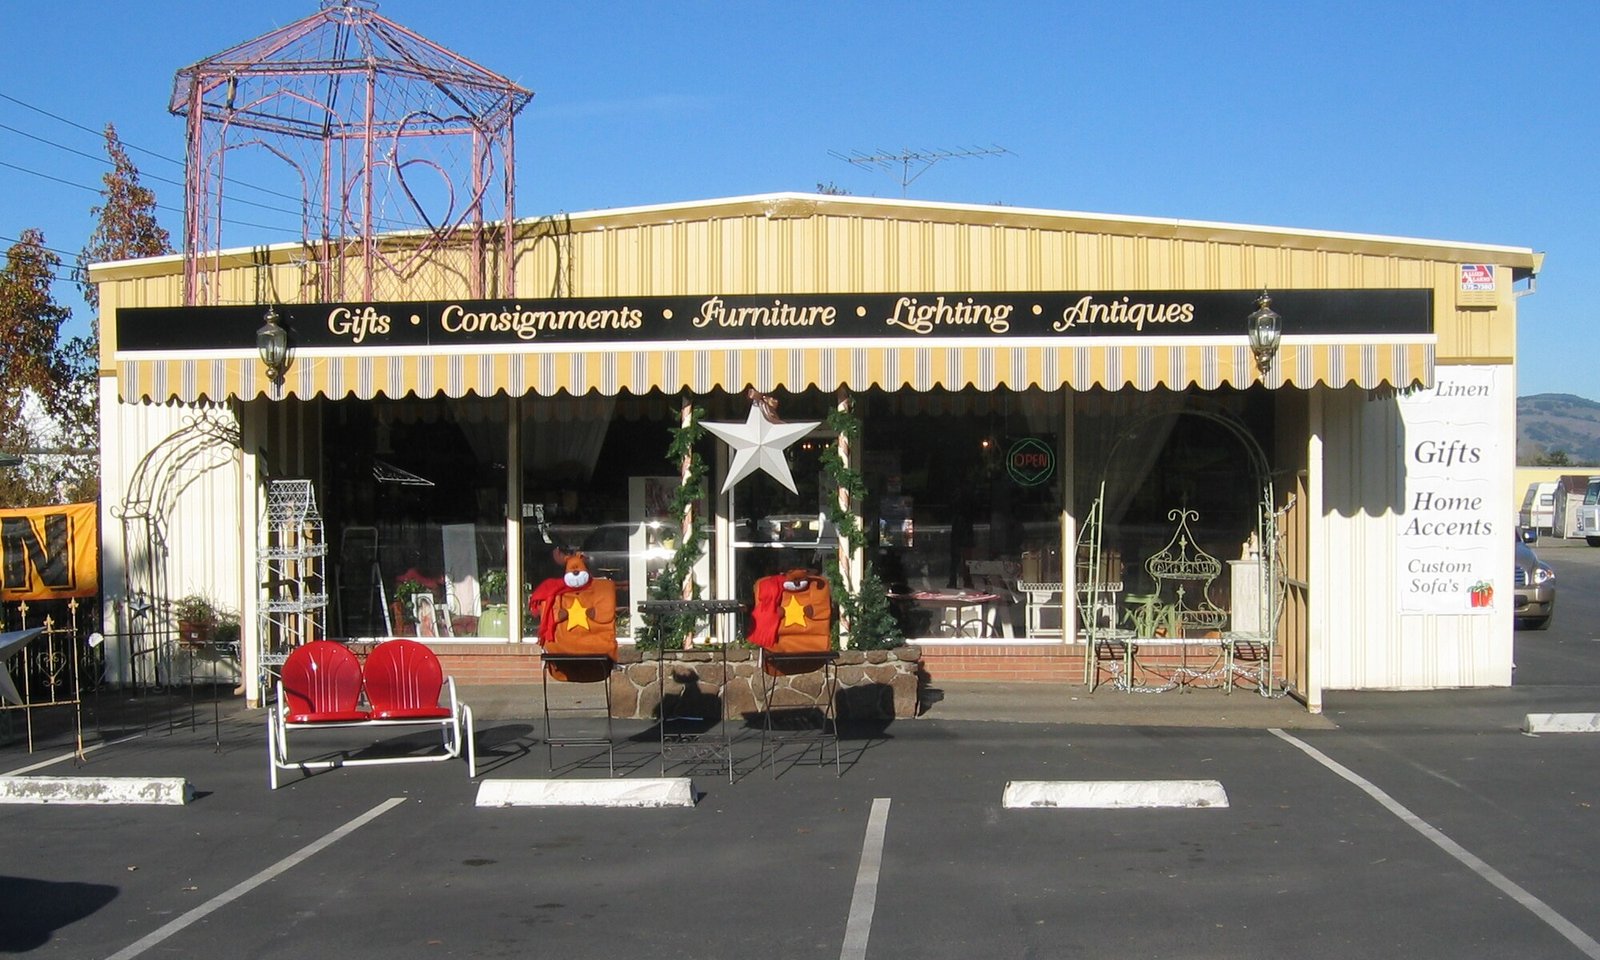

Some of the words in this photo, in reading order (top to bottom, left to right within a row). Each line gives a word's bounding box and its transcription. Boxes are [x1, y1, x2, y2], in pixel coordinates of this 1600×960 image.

[327, 307, 391, 343] Gifts
[441, 304, 643, 340] Consignments
[692, 296, 837, 328] Furniture
[886, 296, 1014, 334] Lighting
[1052, 296, 1195, 332] Antiques
[1435, 381, 1489, 397] Linen
[1014, 453, 1048, 467] OPEN
[1414, 440, 1481, 467] Gifts
[1412, 492, 1482, 511] Home
[1404, 517, 1492, 536] Accents
[1407, 559, 1472, 573] Custom
[1410, 578, 1459, 595] Sofa's
